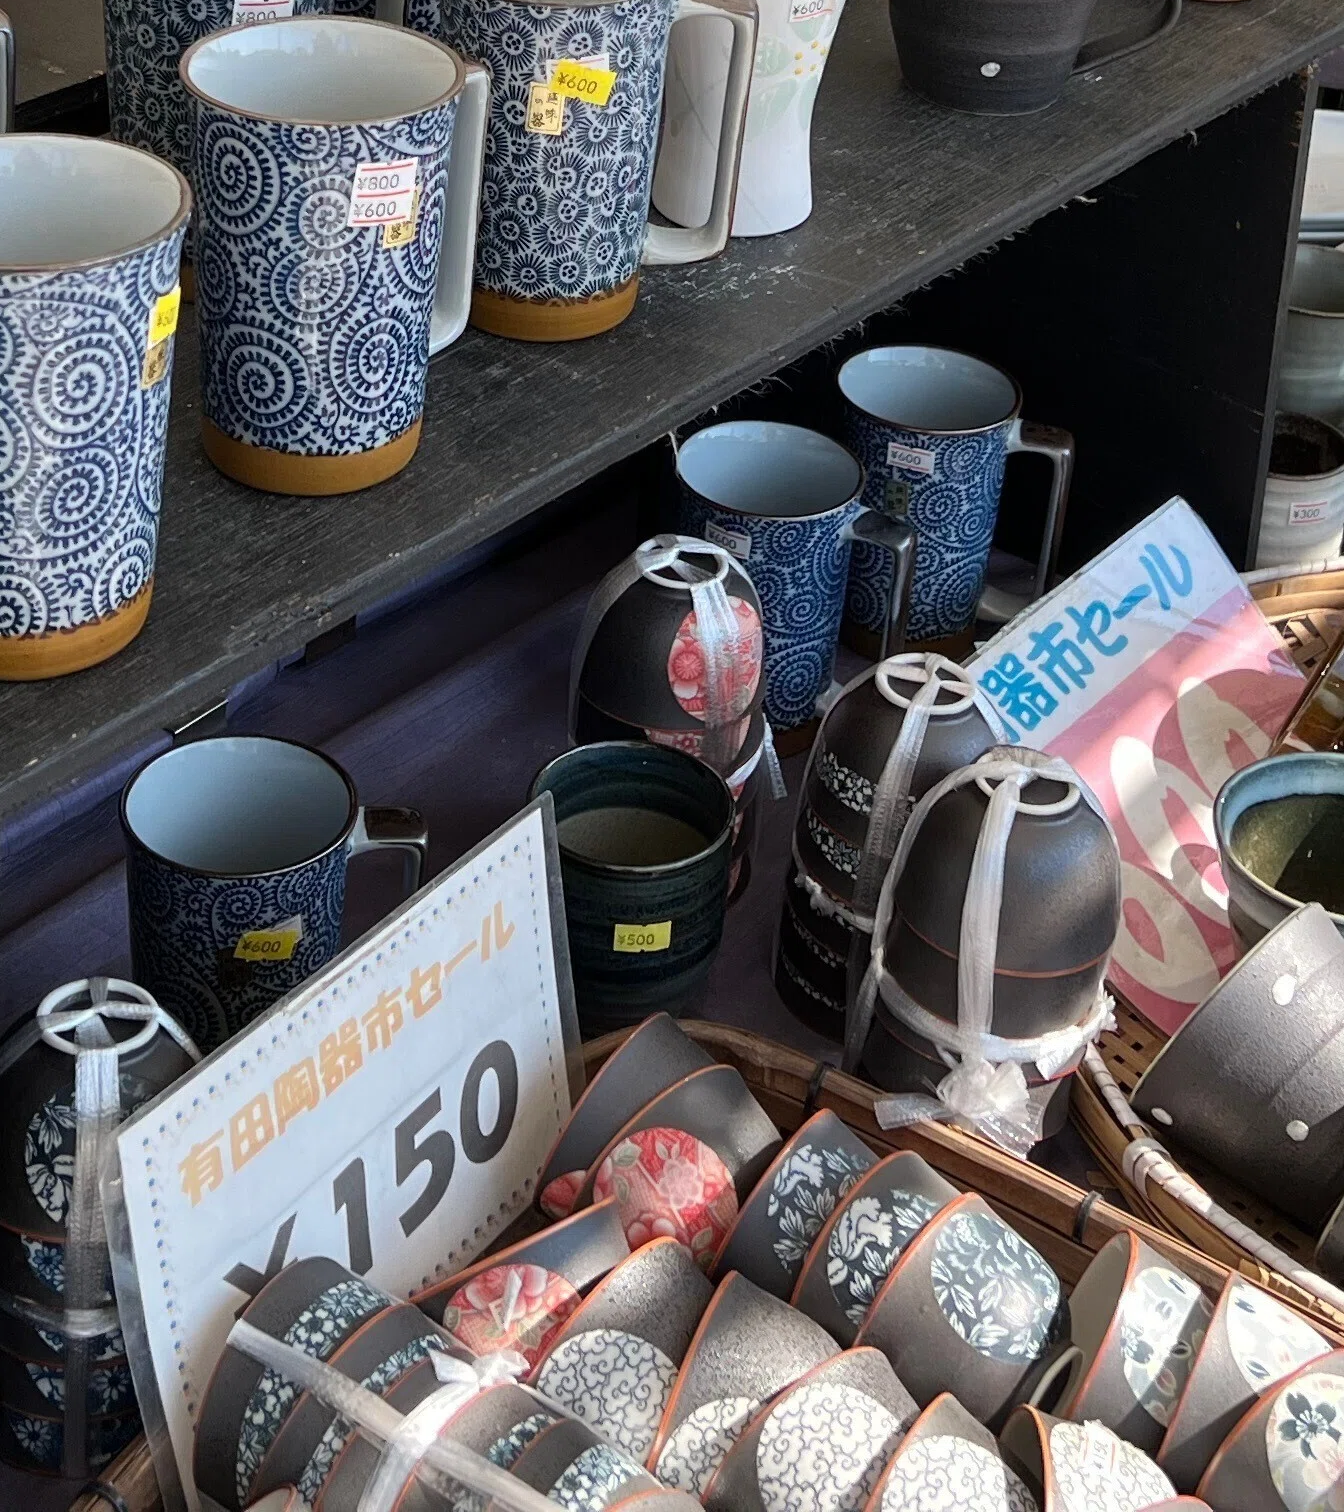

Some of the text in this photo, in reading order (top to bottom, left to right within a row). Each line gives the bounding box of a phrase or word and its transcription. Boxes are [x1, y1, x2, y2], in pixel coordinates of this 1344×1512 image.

[557, 72, 598, 95] ¥600
[356, 172, 399, 191] ¥800
[353, 200, 397, 219] ¥600
[890, 450, 921, 465] ¥600
[1293, 508, 1320, 519] ¥300
[978, 543, 1195, 745] 器市セール
[242, 940, 281, 953] ¥600
[616, 933, 655, 947] ¥500
[177, 900, 516, 1208] 有田陶器市セール
[222, 1038, 519, 1318] ¥150
